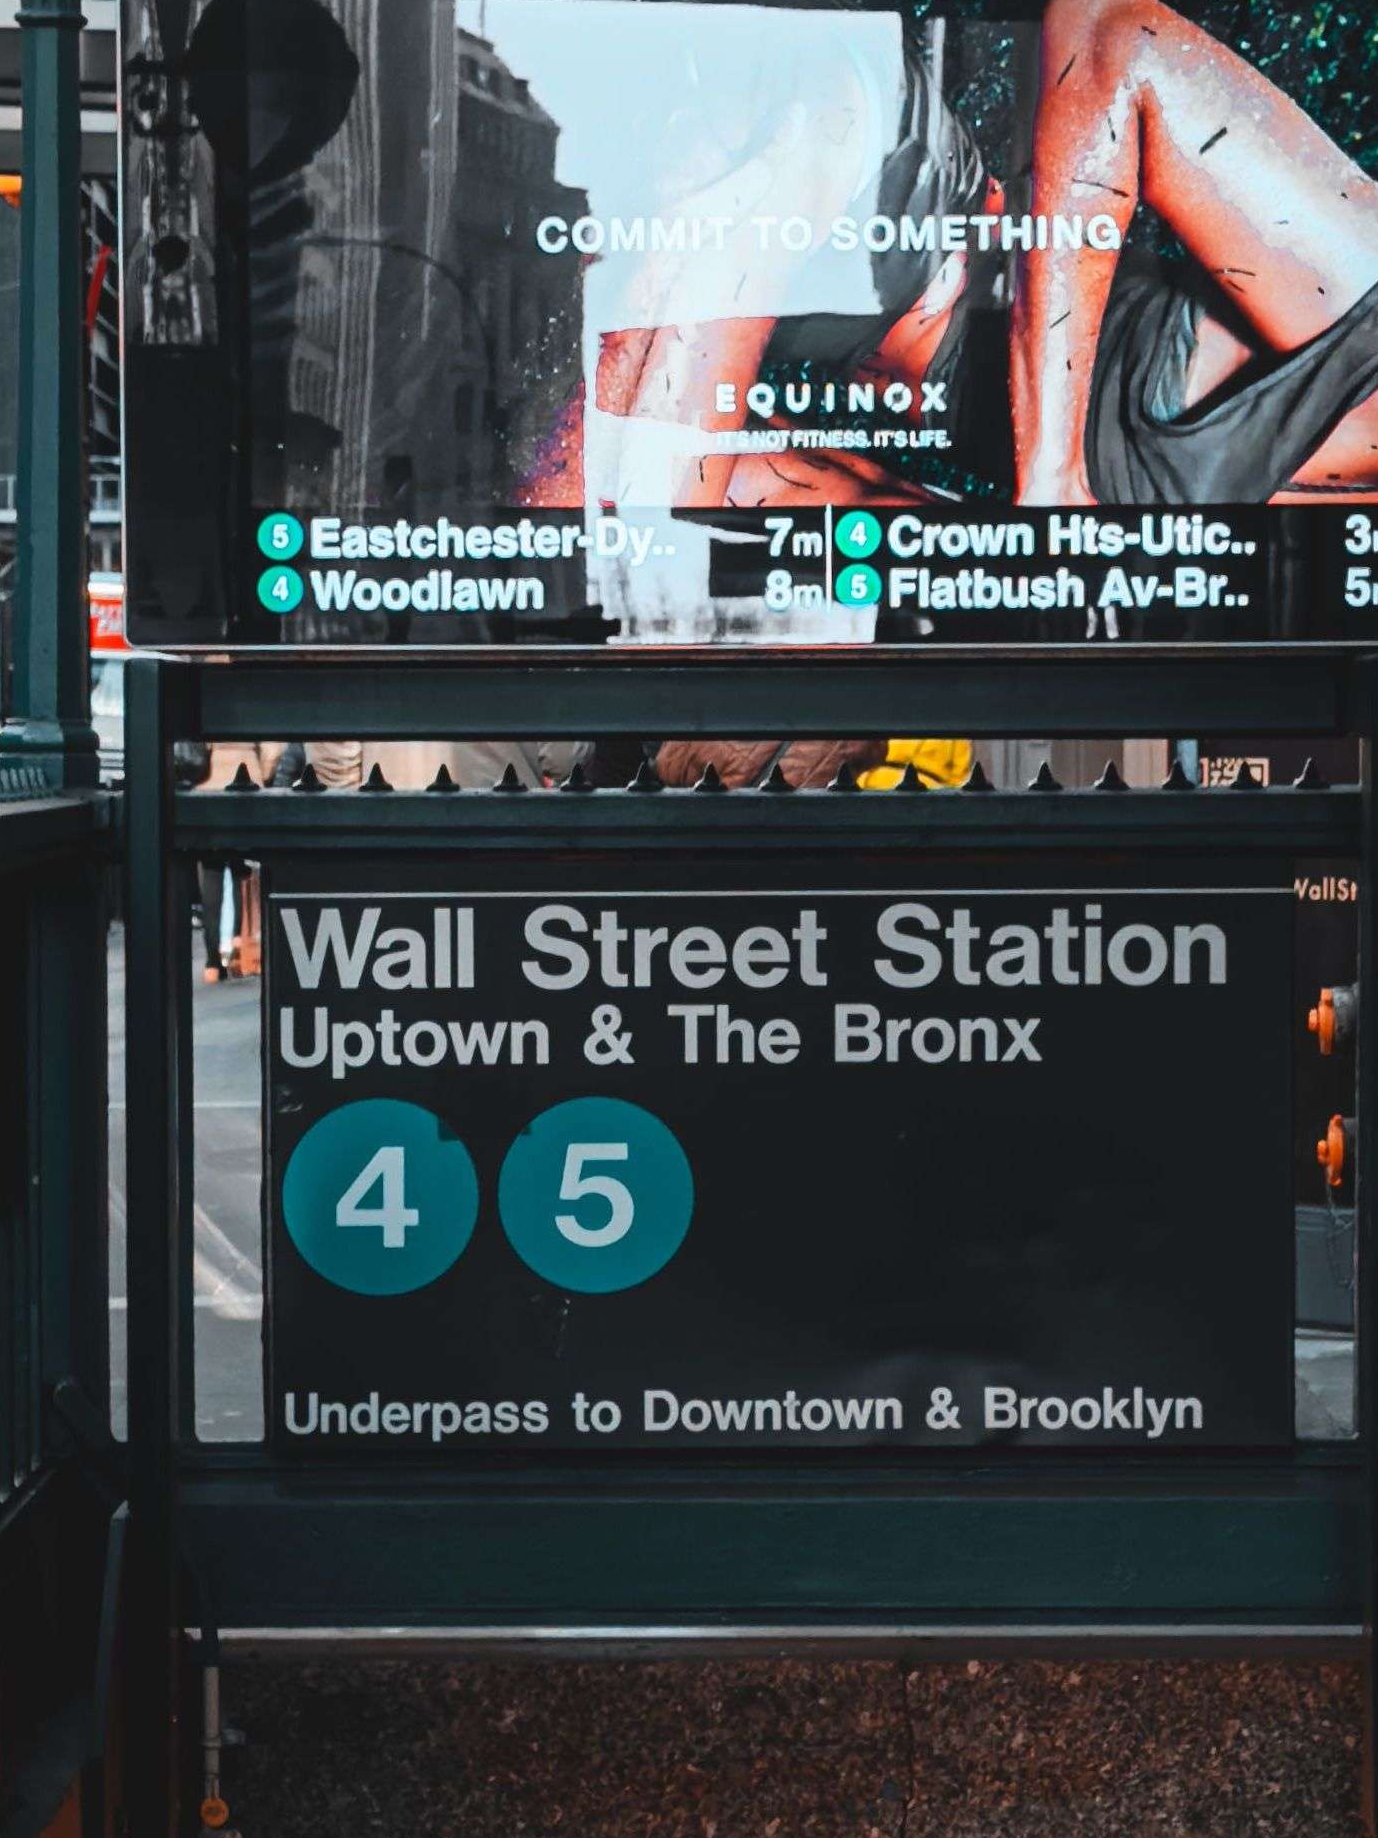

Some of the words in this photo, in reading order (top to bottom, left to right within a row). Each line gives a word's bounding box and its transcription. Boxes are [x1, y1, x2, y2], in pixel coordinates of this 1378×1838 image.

[536, 215, 734, 254] COMMIT
[750, 215, 813, 252] TO
[830, 213, 1123, 253] SOMETHING
[715, 381, 948, 419] EQUINOX
[751, 430, 790, 448] NOT
[791, 429, 871, 449] FITNESS.
[272, 523, 289, 549] 5
[310, 516, 676, 565] Eastchester-Dy..
[764, 517, 823, 557] 7m
[849, 521, 867, 547] 4
[887, 514, 1035, 558] Crown
[1048, 513, 1256, 557] Hts-Utic..
[272, 575, 289, 601] 4
[309, 569, 544, 612] Woodlawn
[765, 569, 824, 611] 8m
[850, 573, 867, 599] 5
[889, 566, 1085, 609] Flatbush
[1097, 566, 1249, 609] Av-Br..
[280, 906, 475, 989] Wall
[521, 904, 828, 989] Street
[873, 902, 1227, 989] Station
[280, 1006, 550, 1080] Uptown
[583, 1003, 635, 1066] &
[667, 1003, 801, 1065] The
[834, 1003, 1043, 1065] Bronx
[336, 1146, 419, 1248] 4
[554, 1142, 635, 1248] 5
[285, 1391, 549, 1442] Underpass
[571, 1392, 622, 1433] to
[643, 1389, 903, 1432] Downtown
[925, 1386, 962, 1431] &
[983, 1386, 1203, 1439] Brooklyn
